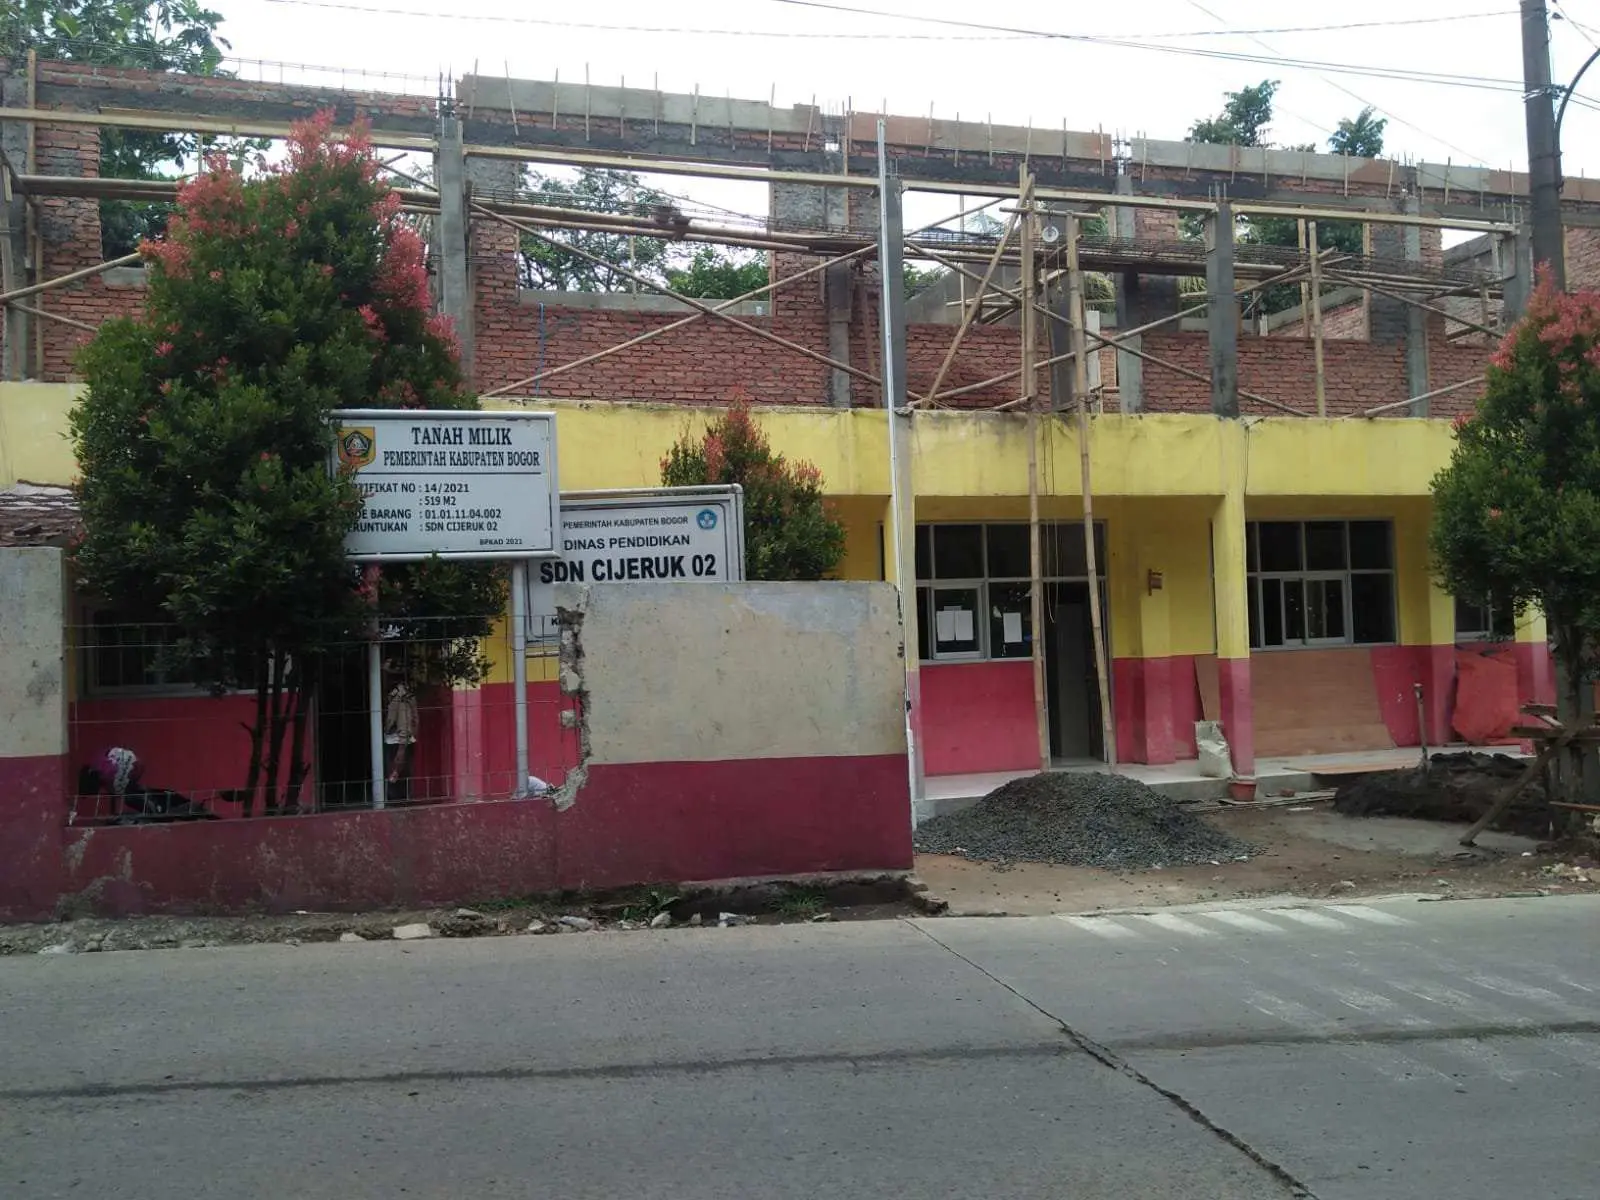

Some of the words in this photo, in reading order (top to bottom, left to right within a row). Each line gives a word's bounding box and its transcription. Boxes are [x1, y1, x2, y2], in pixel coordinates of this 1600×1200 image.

[411, 427, 464, 445] TANAH
[468, 427, 512, 445] MILIK
[383, 450, 447, 466] PEMERINTAH
[449, 451, 504, 466] KABUPATEN
[507, 451, 540, 466] BOGOR
[401, 482, 416, 493] NO
[424, 482, 470, 494] 14/2021
[424, 495, 441, 506] 519
[443, 495, 457, 506] M2
[370, 508, 412, 519] BARANG
[424, 508, 502, 519] 01.01.11.04.002
[425, 521, 445, 532] SDN
[446, 521, 485, 532] CIJERUK
[486, 520, 499, 531] 02
[563, 520, 612, 530] PEMERINTAH
[614, 517, 660, 528] KABUPATEN
[660, 515, 689, 526] BOGOR
[563, 538, 606, 551] DINAS
[609, 534, 690, 549] PENDIDIKAN
[539, 559, 585, 584] SDN
[591, 555, 687, 581] CIJERUK
[691, 553, 717, 576] 02
